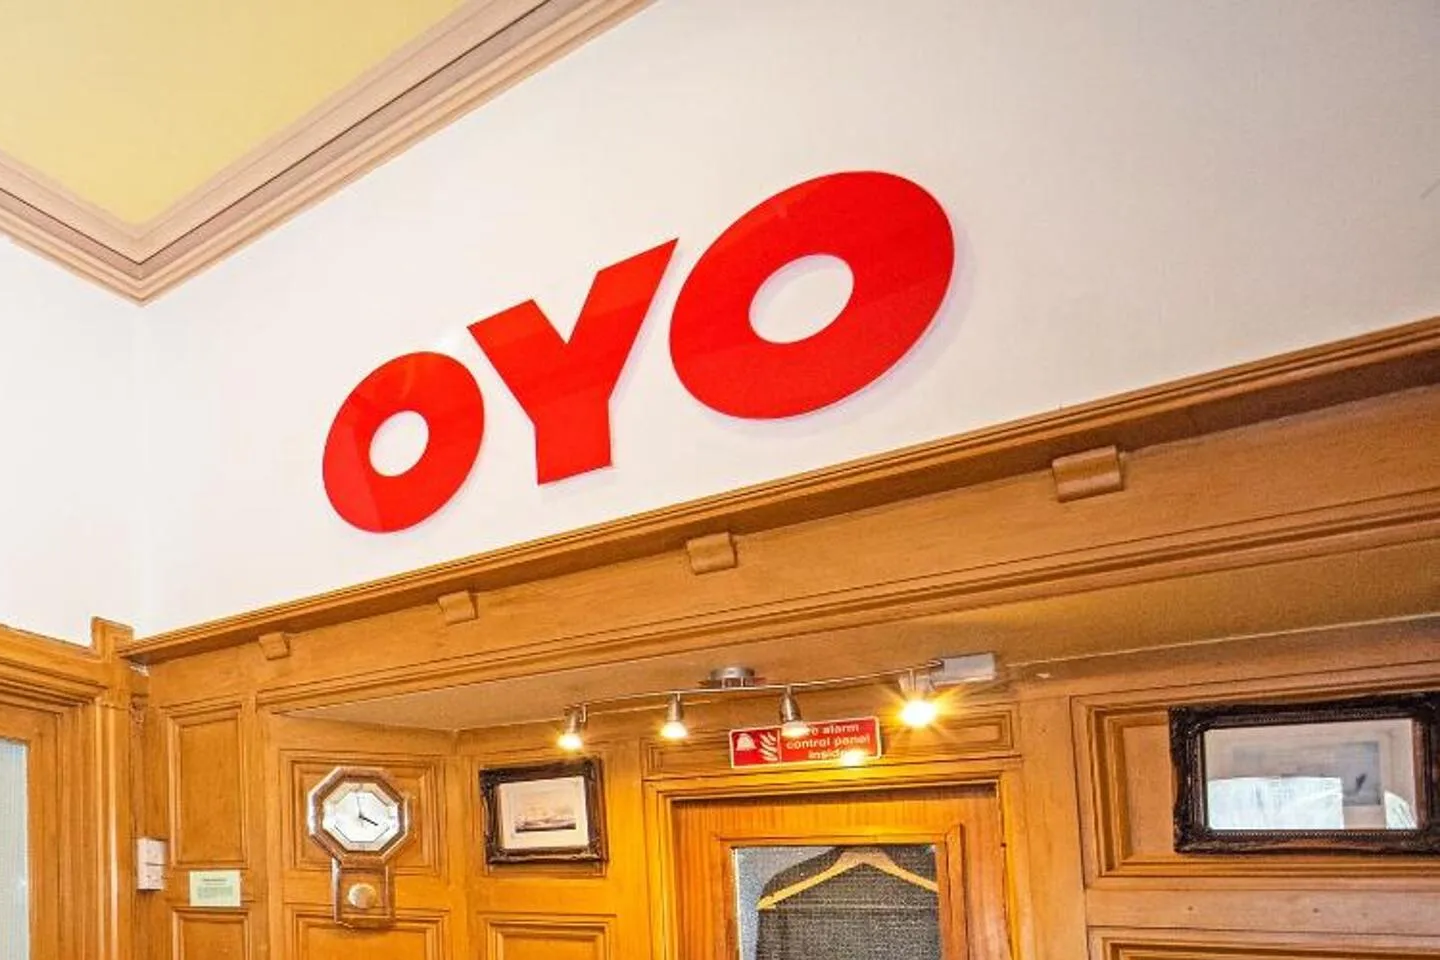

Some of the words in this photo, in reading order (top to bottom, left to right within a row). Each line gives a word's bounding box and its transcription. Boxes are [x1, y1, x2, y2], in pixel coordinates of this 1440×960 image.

[322, 171, 955, 534] OYO
[823, 723, 859, 735] alarm
[786, 737, 830, 750] control
[834, 733, 870, 747] panel
[808, 748, 847, 760] insid
